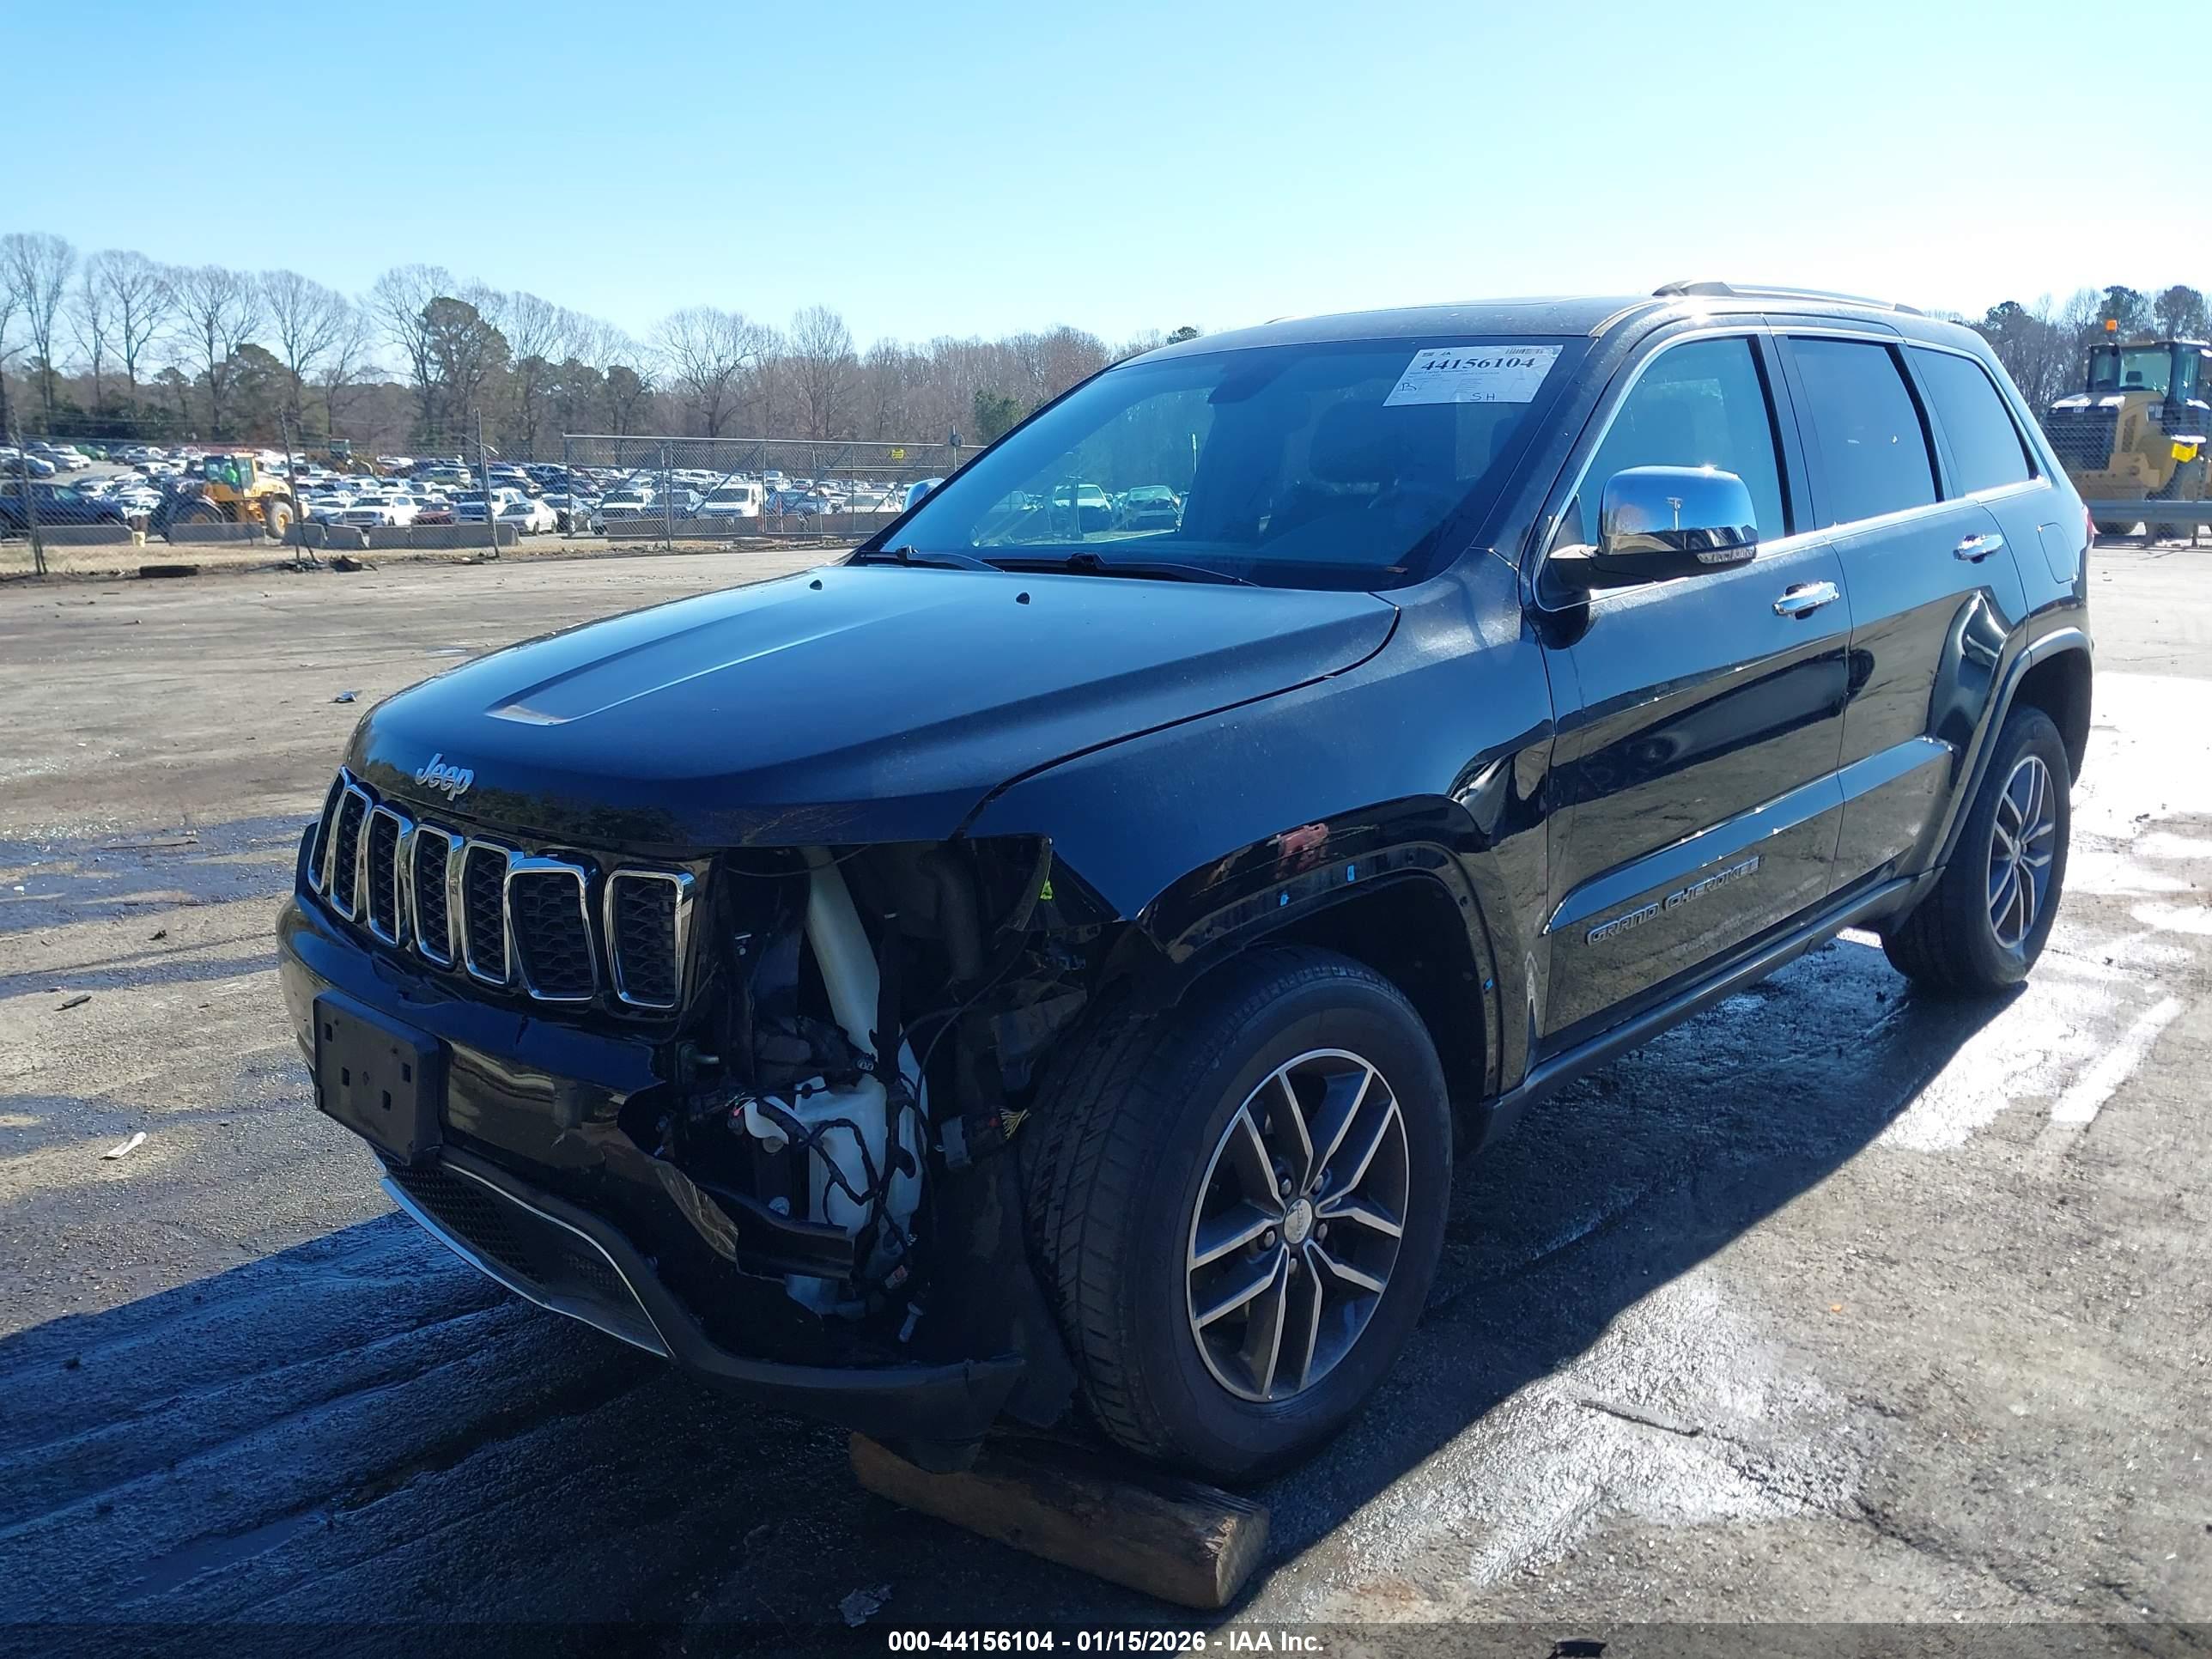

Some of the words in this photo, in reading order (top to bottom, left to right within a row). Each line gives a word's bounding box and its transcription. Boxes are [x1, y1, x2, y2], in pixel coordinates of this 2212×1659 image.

[1421, 357, 1536, 371] 44156104
[415, 752, 475, 801] Jeep
[1587, 902, 1660, 945] GRAND
[1663, 855, 1759, 910] CHEROKEE
